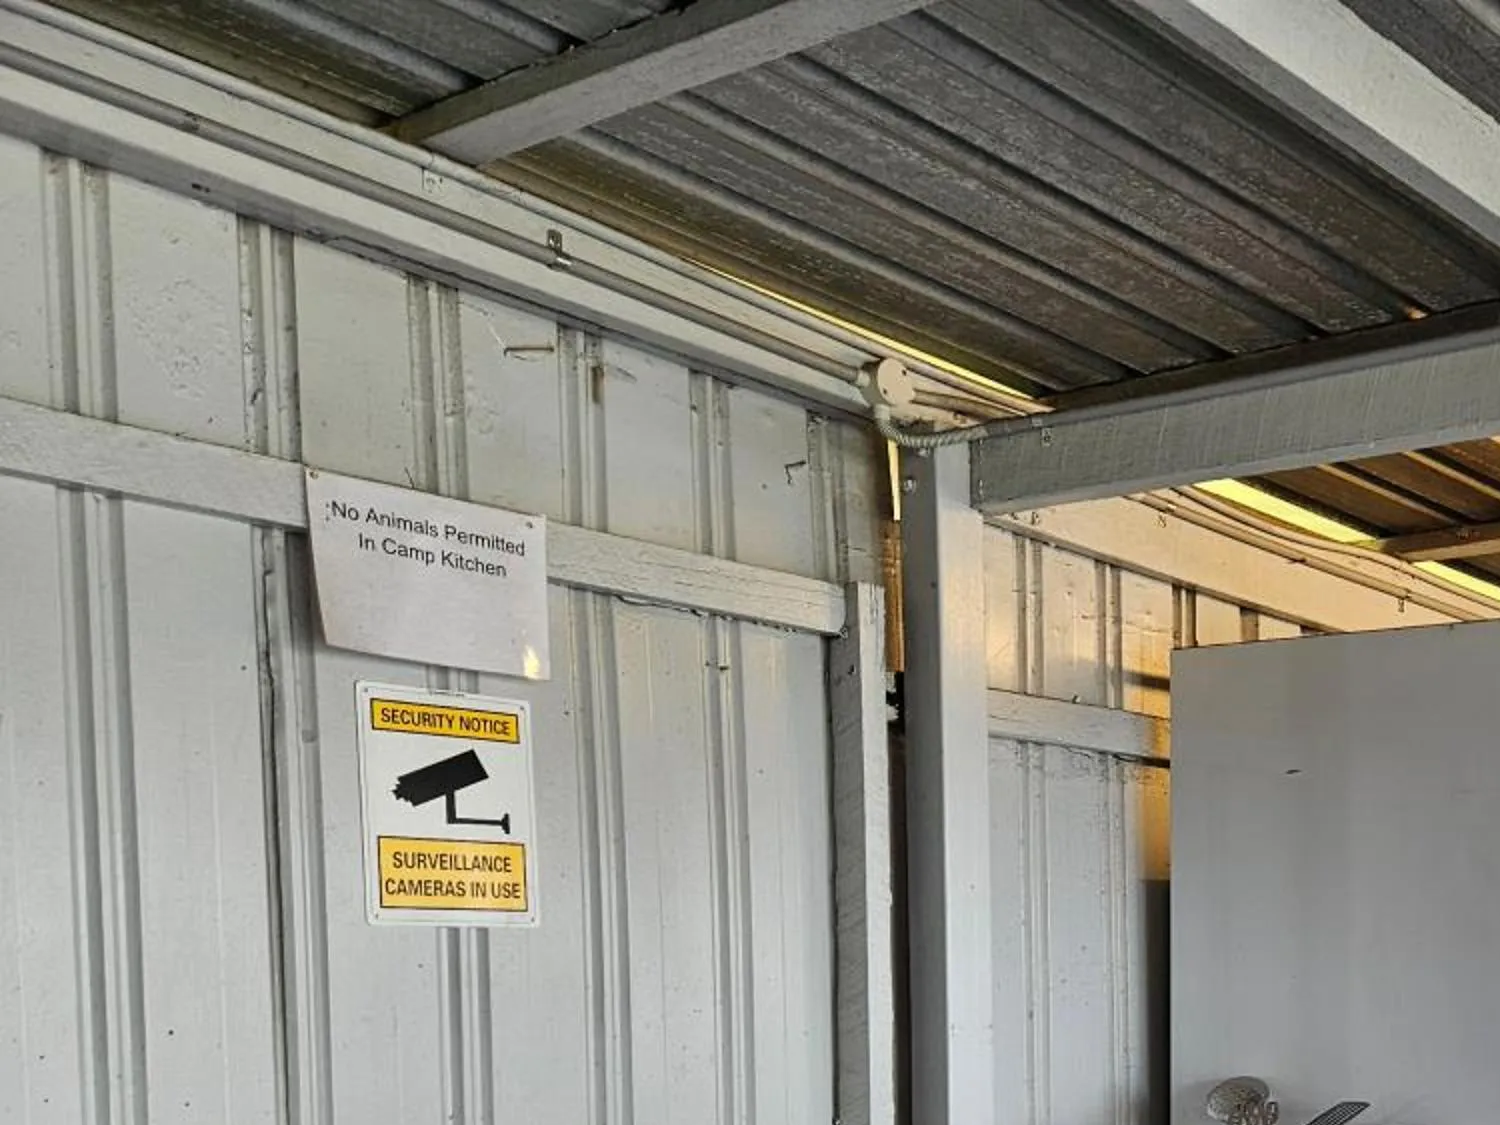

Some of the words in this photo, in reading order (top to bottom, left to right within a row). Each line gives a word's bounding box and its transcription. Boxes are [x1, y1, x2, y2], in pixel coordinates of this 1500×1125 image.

[331, 501, 359, 521] No
[366, 508, 438, 538] Animals
[445, 524, 525, 556] Permitted
[359, 534, 375, 551] In
[382, 538, 435, 566] Camp
[441, 550, 507, 577] Kitchen
[381, 707, 455, 730] SECURITY
[459, 716, 510, 736] NOTICE
[393, 851, 512, 873] SURVEILLANCE
[385, 878, 466, 898] CAMERAS
[470, 881, 486, 898] IN
[491, 881, 521, 899] USE
